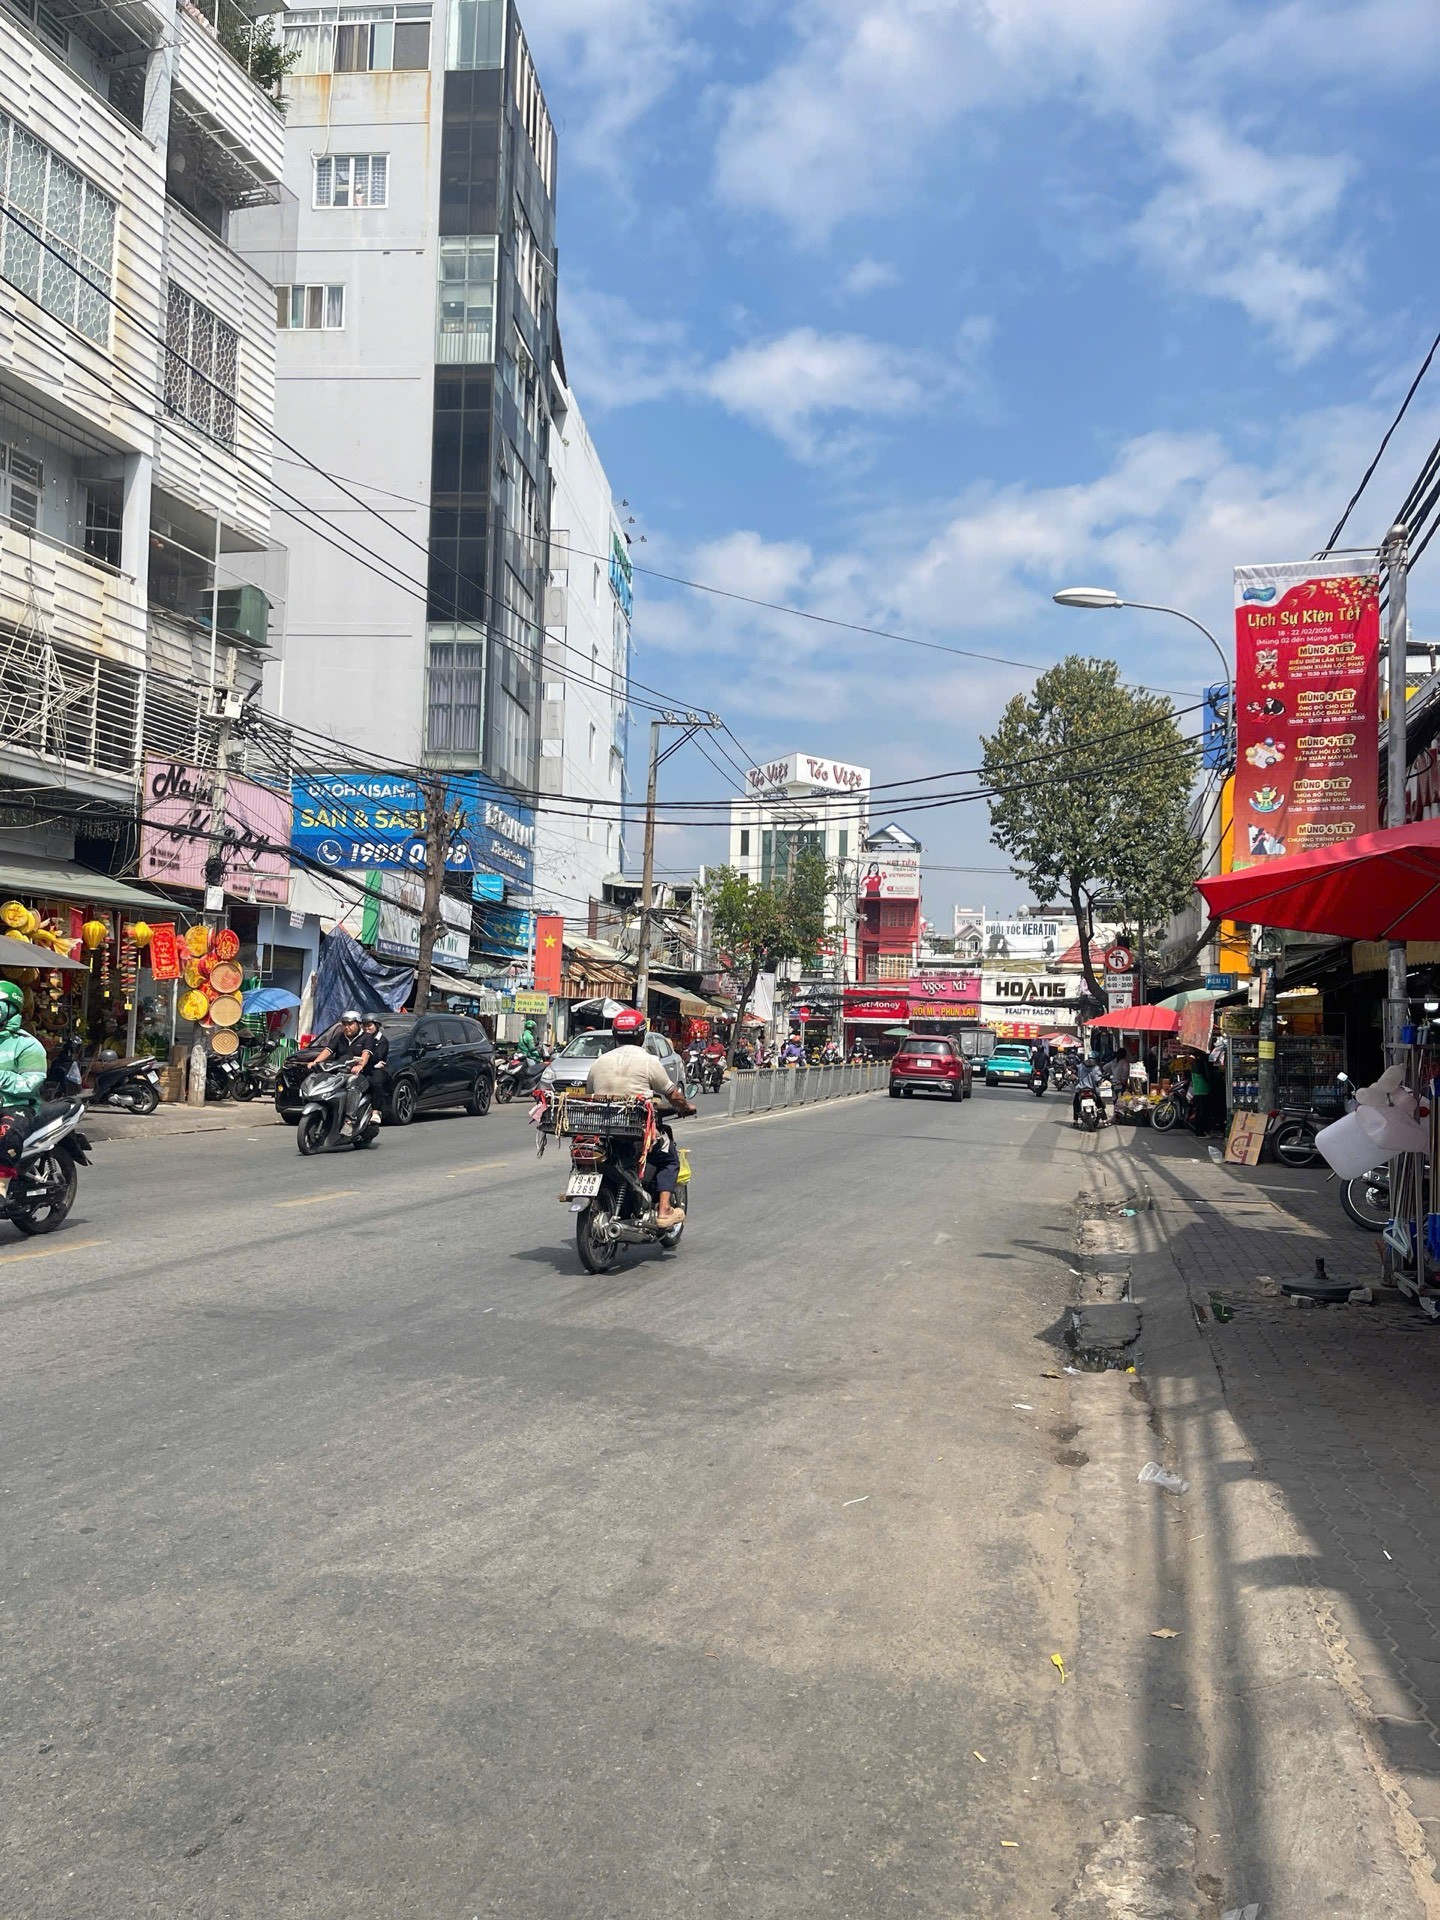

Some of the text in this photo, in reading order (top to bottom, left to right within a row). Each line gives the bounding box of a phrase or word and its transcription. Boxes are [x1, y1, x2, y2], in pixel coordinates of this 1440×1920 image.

[1248, 604, 1361, 629] Lịch Sự Kiện Tết
[1299, 645, 1325, 655] MÙNG
[1336, 642, 1355, 653] TẾT
[1299, 689, 1355, 702] MÙNG 3 TẾT
[1299, 734, 1354, 747] MÙNG 4 TẾT
[832, 764, 862, 790] Việt
[1295, 777, 1350, 789] MÙNG 5 TẾT
[353, 809, 369, 829] &
[1299, 824, 1325, 834] MÙNG
[1335, 822, 1354, 833] TẾT
[350, 843, 404, 863] 1900
[1023, 923, 1057, 936] KERATIN
[996, 978, 1066, 1001] HOÀNG
[941, 1006, 960, 1017] PHUN
